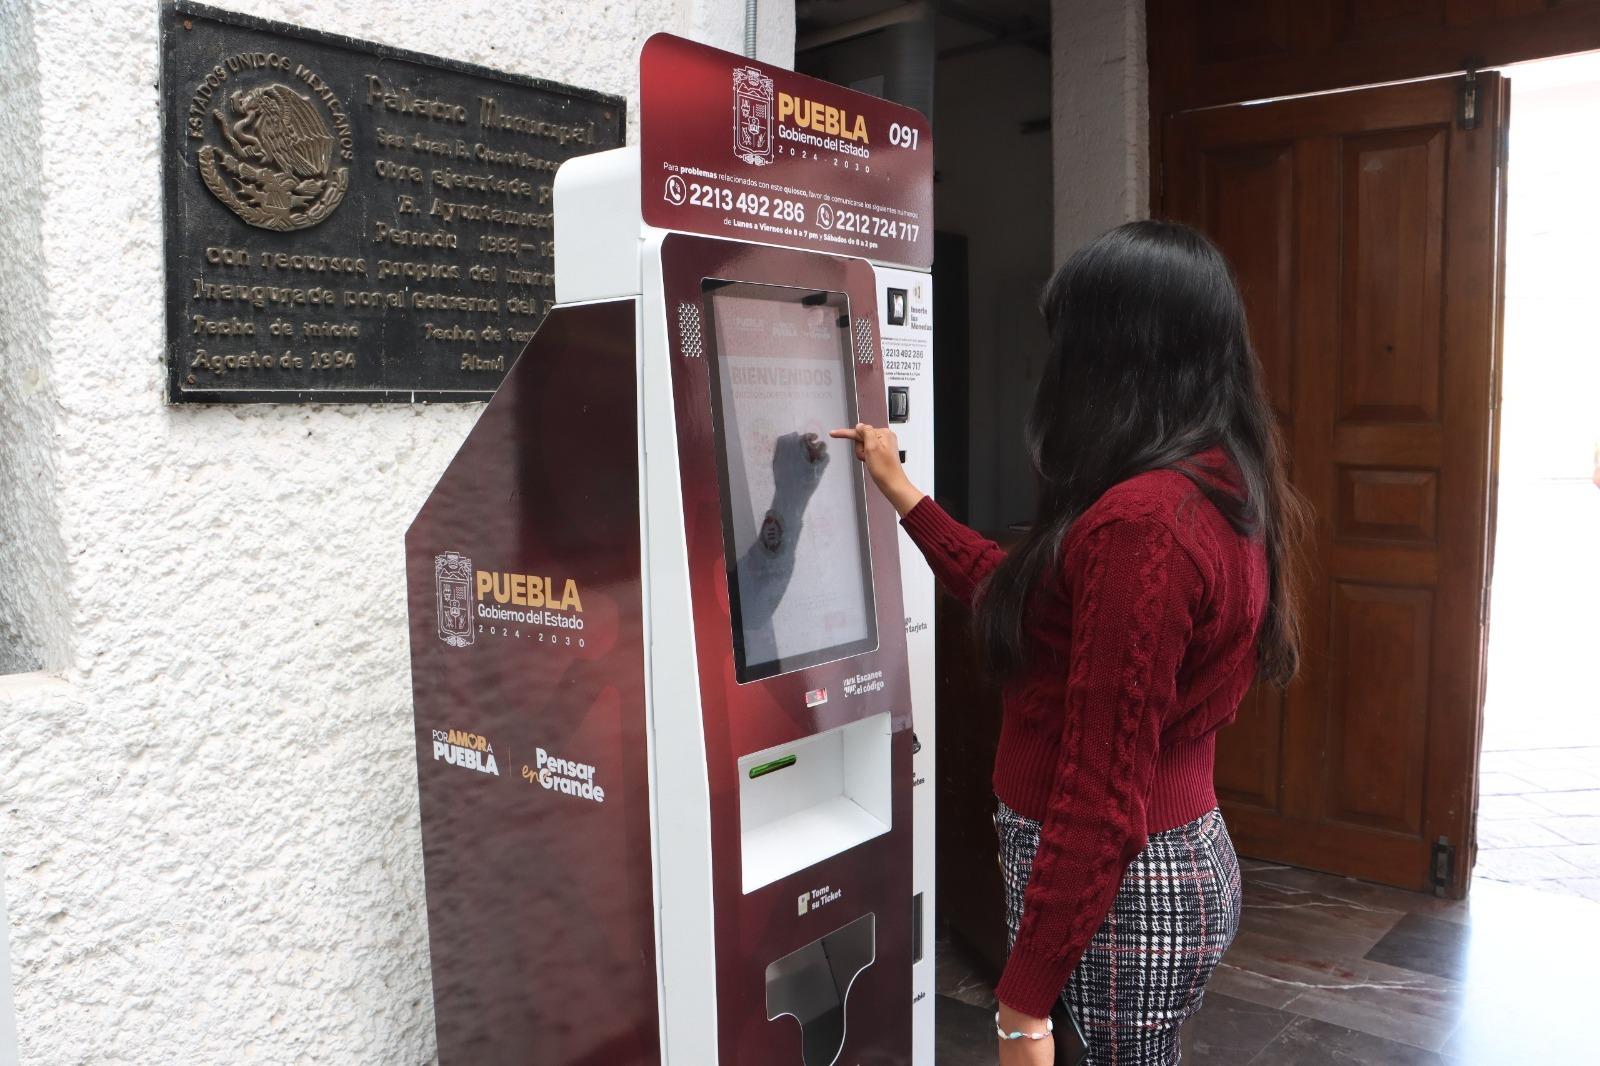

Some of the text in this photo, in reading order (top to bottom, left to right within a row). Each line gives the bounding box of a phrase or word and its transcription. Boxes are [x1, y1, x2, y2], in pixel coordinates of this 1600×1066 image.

[189, 52, 353, 160] ESTADOS UNIDOS MEXICANOS
[778, 92, 869, 144] PUEBLA
[778, 125, 870, 159] Gobierno del Estado
[889, 122, 919, 150] 091
[663, 162, 679, 172] Para
[680, 166, 718, 179] problemas
[718, 173, 758, 187] relacionados
[759, 181, 769, 189] con
[771, 184, 783, 192] este
[784, 184, 808, 198] quiosco,
[824, 193, 831, 201] de
[690, 183, 805, 223] 2213 492 286
[723, 218, 732, 226] de
[733, 219, 753, 229] Lunes
[760, 223, 783, 234] Viernes
[785, 227, 792, 235] de
[809, 231, 819, 240] pm
[824, 233, 847, 244] Sábados
[848, 237, 855, 245] de
[836, 210, 920, 243] 2212 724 717
[261, 252, 367, 273] recursos
[469, 265, 497, 282] del
[506, 297, 537, 314] del
[193, 314, 256, 335] Fecha
[270, 318, 294, 335] de
[481, 325, 502, 341] de
[280, 350, 304, 368] de
[886, 348, 900, 358] 2213
[886, 360, 900, 370] 2212
[730, 366, 833, 386] BIENVENIDOS
[476, 571, 583, 612] PUEBLA
[478, 603, 584, 630] Gobierno del Estado
[909, 622, 927, 632] tarjeta
[857, 681, 885, 694] el código
[432, 729, 493, 753] POR AMOR A
[433, 740, 500, 776] PUEBLA
[536, 747, 596, 780] Pensar
[522, 764, 605, 803] en Grande
[812, 886, 829, 898] Tome
[812, 889, 841, 909] su Ticket
